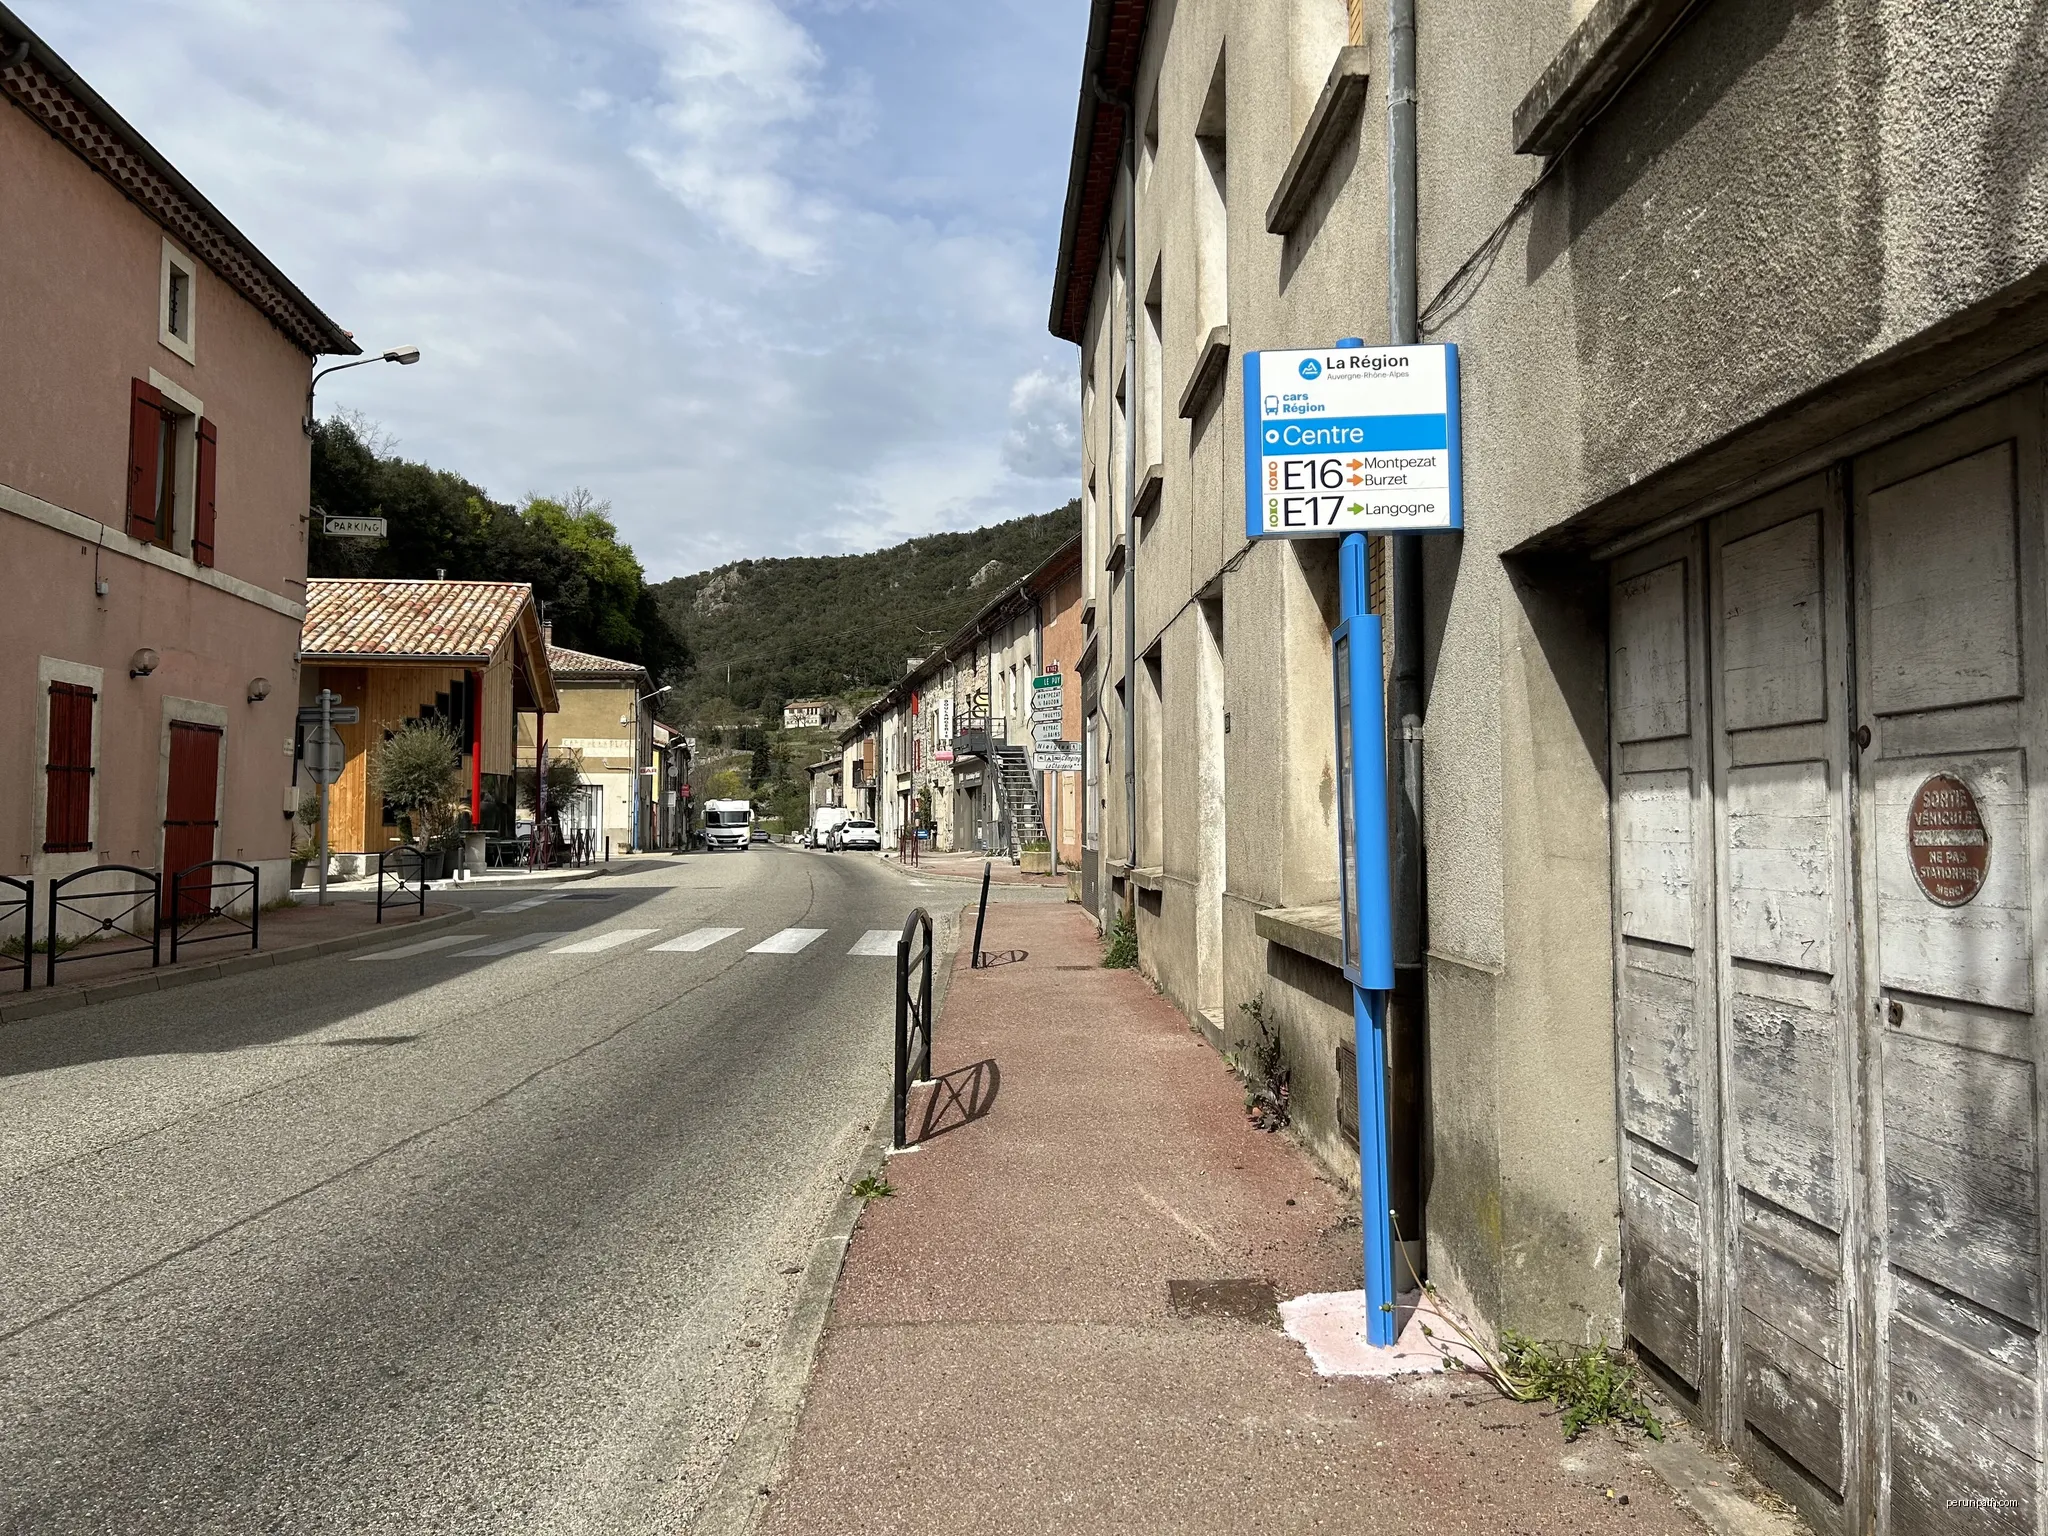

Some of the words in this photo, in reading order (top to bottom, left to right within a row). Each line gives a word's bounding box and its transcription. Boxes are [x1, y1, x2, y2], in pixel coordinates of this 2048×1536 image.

[1326, 356, 1345, 370] La
[1349, 354, 1409, 371] Région
[1326, 371, 1410, 381] Auvergne-Rhône-Alpes
[1283, 392, 1309, 402] cars
[1283, 402, 1326, 415] Région
[1283, 425, 1364, 446] Centre
[1364, 455, 1437, 471] Montpezat
[1284, 458, 1344, 491] E16
[1365, 473, 1408, 487] Burzet
[1284, 495, 1345, 527] E17
[1365, 501, 1435, 517] Langogne
[333, 521, 380, 533] PARKING
[1043, 677, 1050, 686] LE
[1922, 789, 1968, 810] SORTIE
[1928, 851, 1943, 864] NE
[1945, 851, 1968, 864] PAS
[1920, 866, 1980, 881] STATIONNER
[1935, 883, 1965, 897] MERCI
